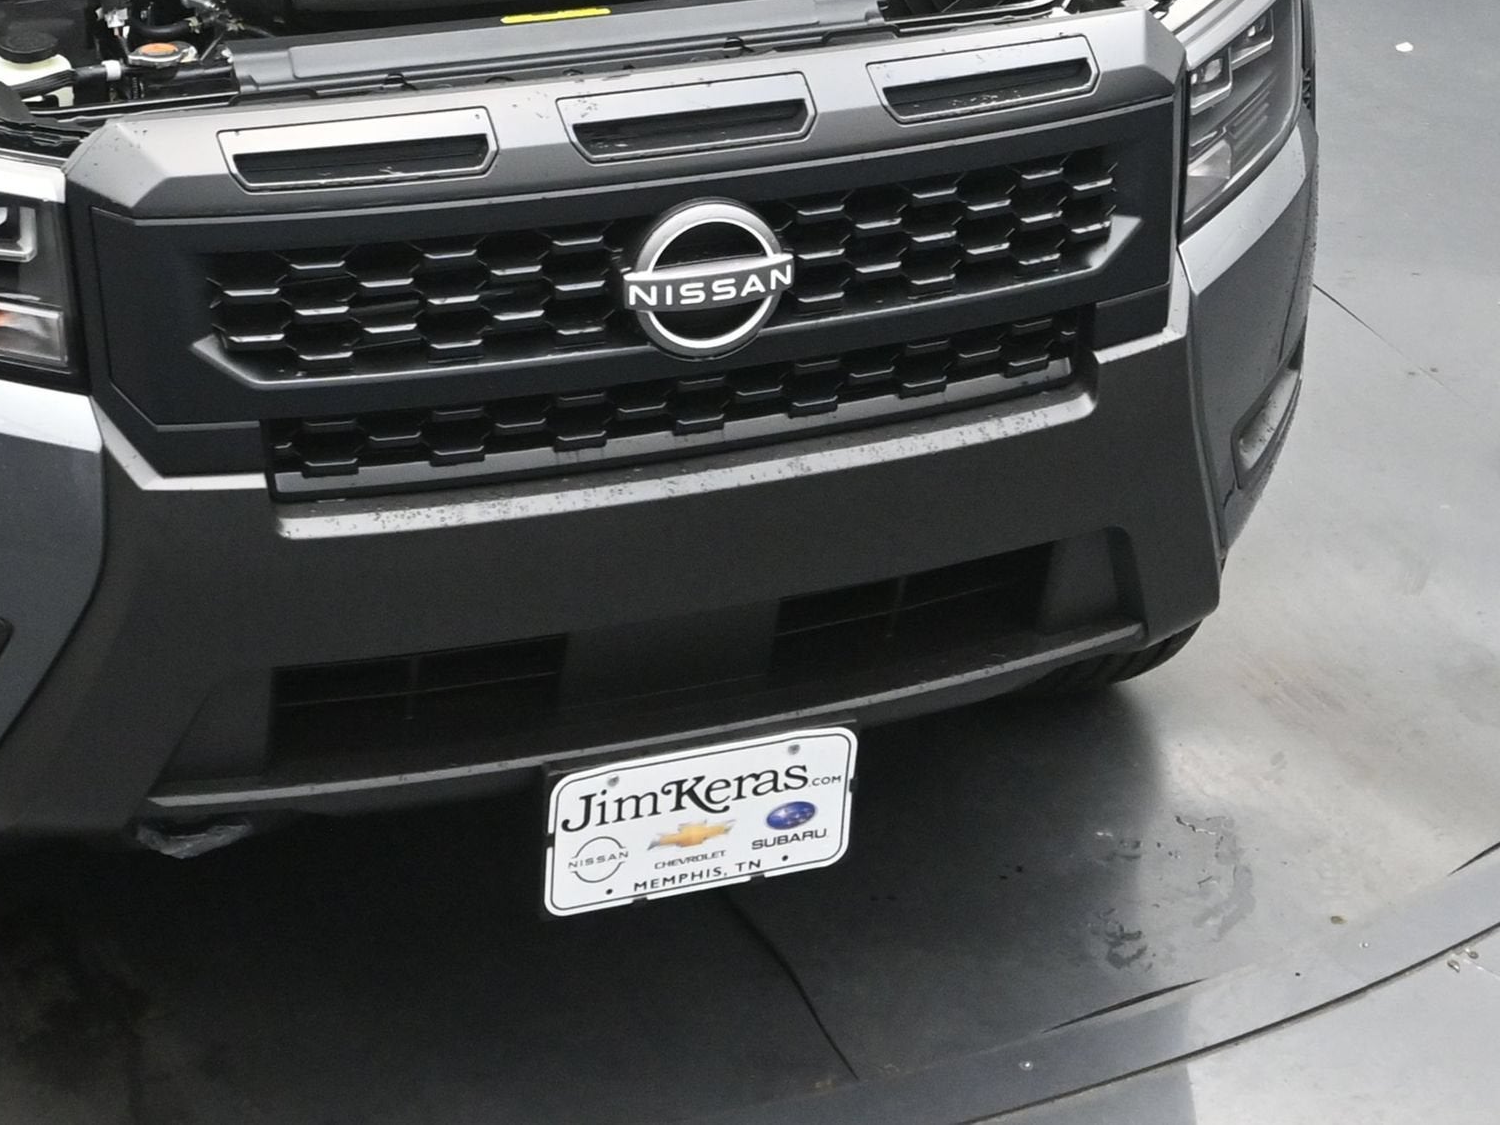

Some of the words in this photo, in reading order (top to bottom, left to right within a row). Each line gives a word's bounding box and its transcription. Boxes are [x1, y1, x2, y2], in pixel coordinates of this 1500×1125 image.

[628, 264, 792, 306] NISSAN
[751, 828, 827, 850] SUBARU
[567, 851, 629, 870] NISSAN
[654, 850, 727, 870] CHEVROLET
[633, 866, 728, 892] MEMPHIS,
[735, 859, 761, 873] TN
